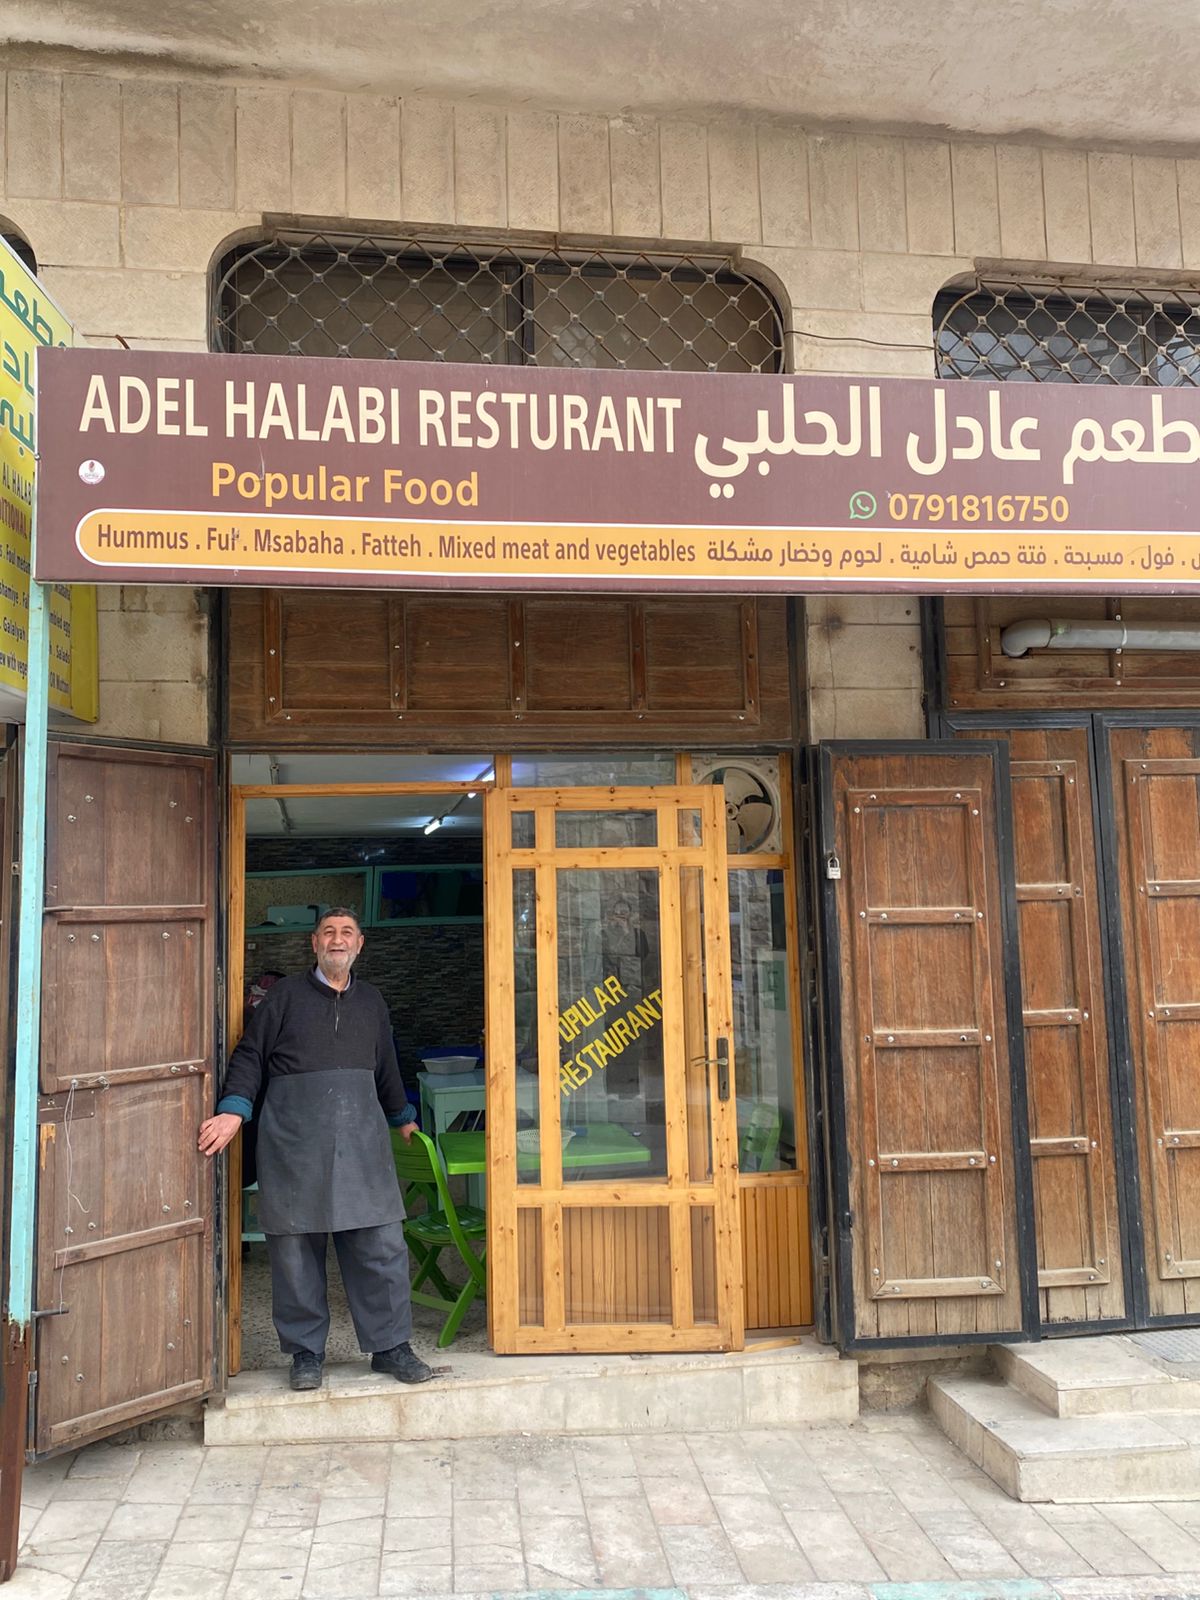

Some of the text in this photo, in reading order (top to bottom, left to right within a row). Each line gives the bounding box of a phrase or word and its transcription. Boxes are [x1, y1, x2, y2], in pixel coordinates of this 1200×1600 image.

[79, 374, 683, 454] ADEL HALABI RESTURANT
[694, 382, 1200, 499] طعم عادل الحلبي
[12, 469, 33, 506] HALAB
[212, 462, 479, 508] Popular Food
[889, 493, 1070, 523] 0791816750
[98, 523, 189, 551] Hummus
[254, 528, 344, 556] Msabaha
[362, 531, 422, 558] Fatteh
[439, 535, 496, 560] Mixed
[502, 538, 550, 561] meat
[555, 537, 590, 562] and
[596, 538, 696, 567] vegetables
[706, 537, 773, 562] مشكلة
[779, 541, 833, 568] وخضار
[839, 542, 882, 570] لحوم
[900, 541, 958, 571] شامية
[1017, 545, 1047, 565] فتة
[1064, 545, 1124, 571] مسبحة
[1140, 544, 1175, 570] فول
[964, 552, 1011, 570] حمص
[559, 975, 628, 1050] OPULAR
